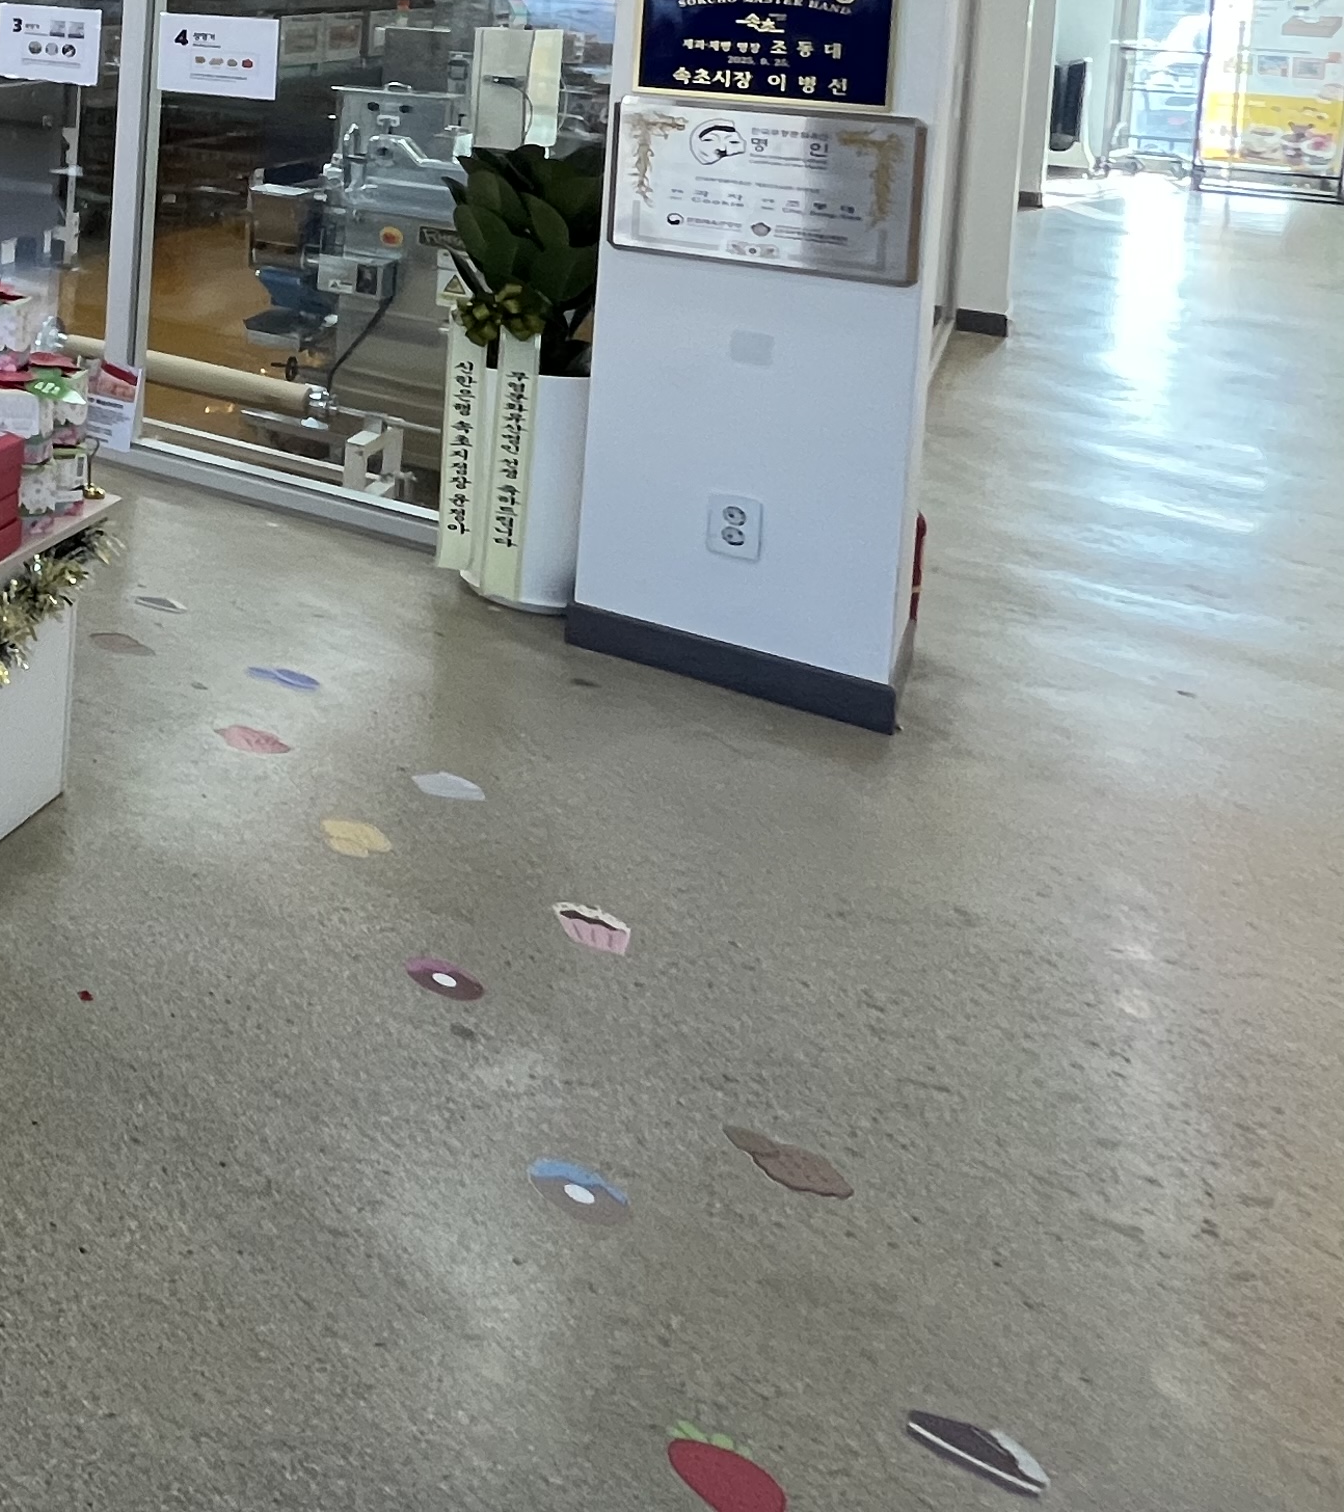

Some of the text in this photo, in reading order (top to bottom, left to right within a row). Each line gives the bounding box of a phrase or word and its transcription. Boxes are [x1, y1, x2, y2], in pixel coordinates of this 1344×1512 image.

[808, 0, 852, 15] HAND
[12, 18, 23, 32] 3
[174, 29, 189, 46] 4
[769, 40, 788, 56] 조
[796, 40, 814, 58] 동
[824, 42, 842, 59] 대
[672, 66, 753, 90] 속초시장
[767, 74, 787, 92] 이
[454, 361, 477, 416] 신한은행
[448, 420, 474, 490] 속초지점장
